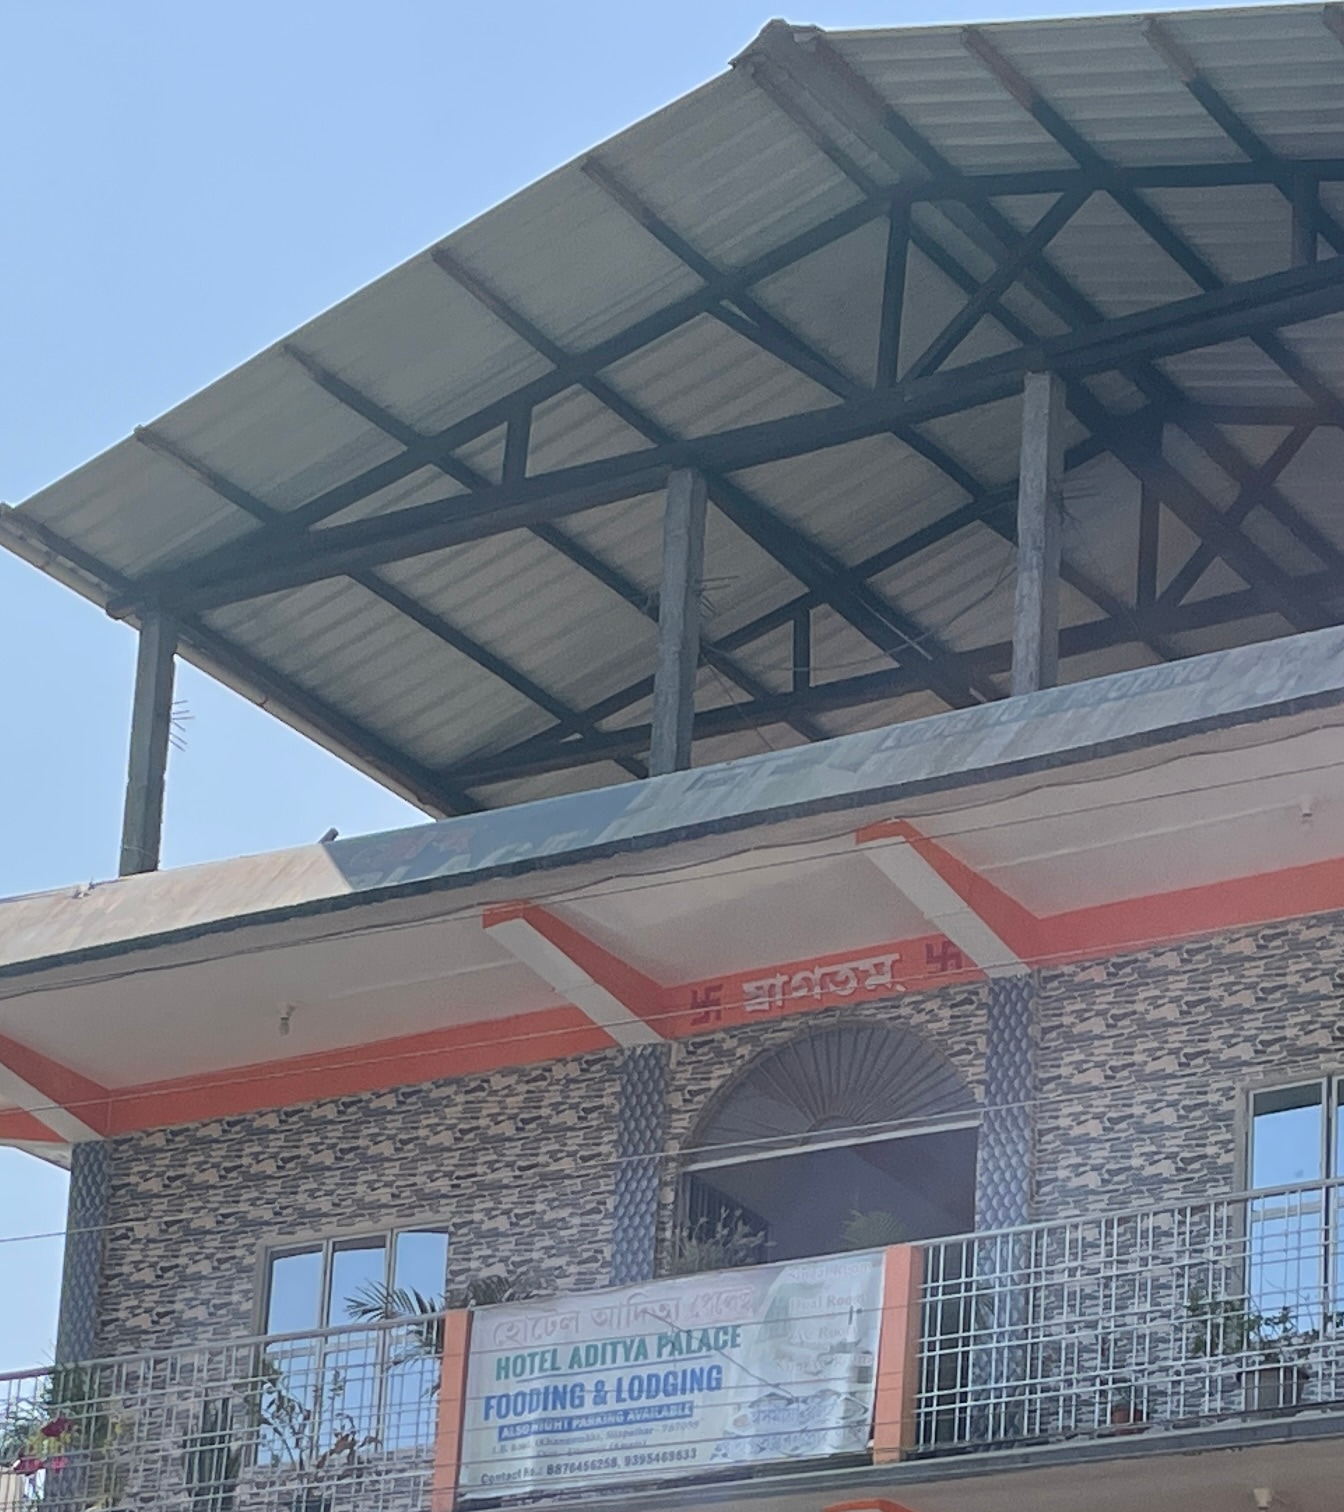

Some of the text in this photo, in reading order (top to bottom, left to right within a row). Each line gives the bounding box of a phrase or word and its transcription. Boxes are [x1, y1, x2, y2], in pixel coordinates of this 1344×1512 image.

[493, 1312, 580, 1350] হোটেল
[495, 1324, 741, 1381] HOTEL ADITYA PALACE
[483, 1364, 724, 1421] FOODING & LODGING
[500, 1423, 530, 1439] ALSO
[572, 1411, 624, 1430] PARKING
